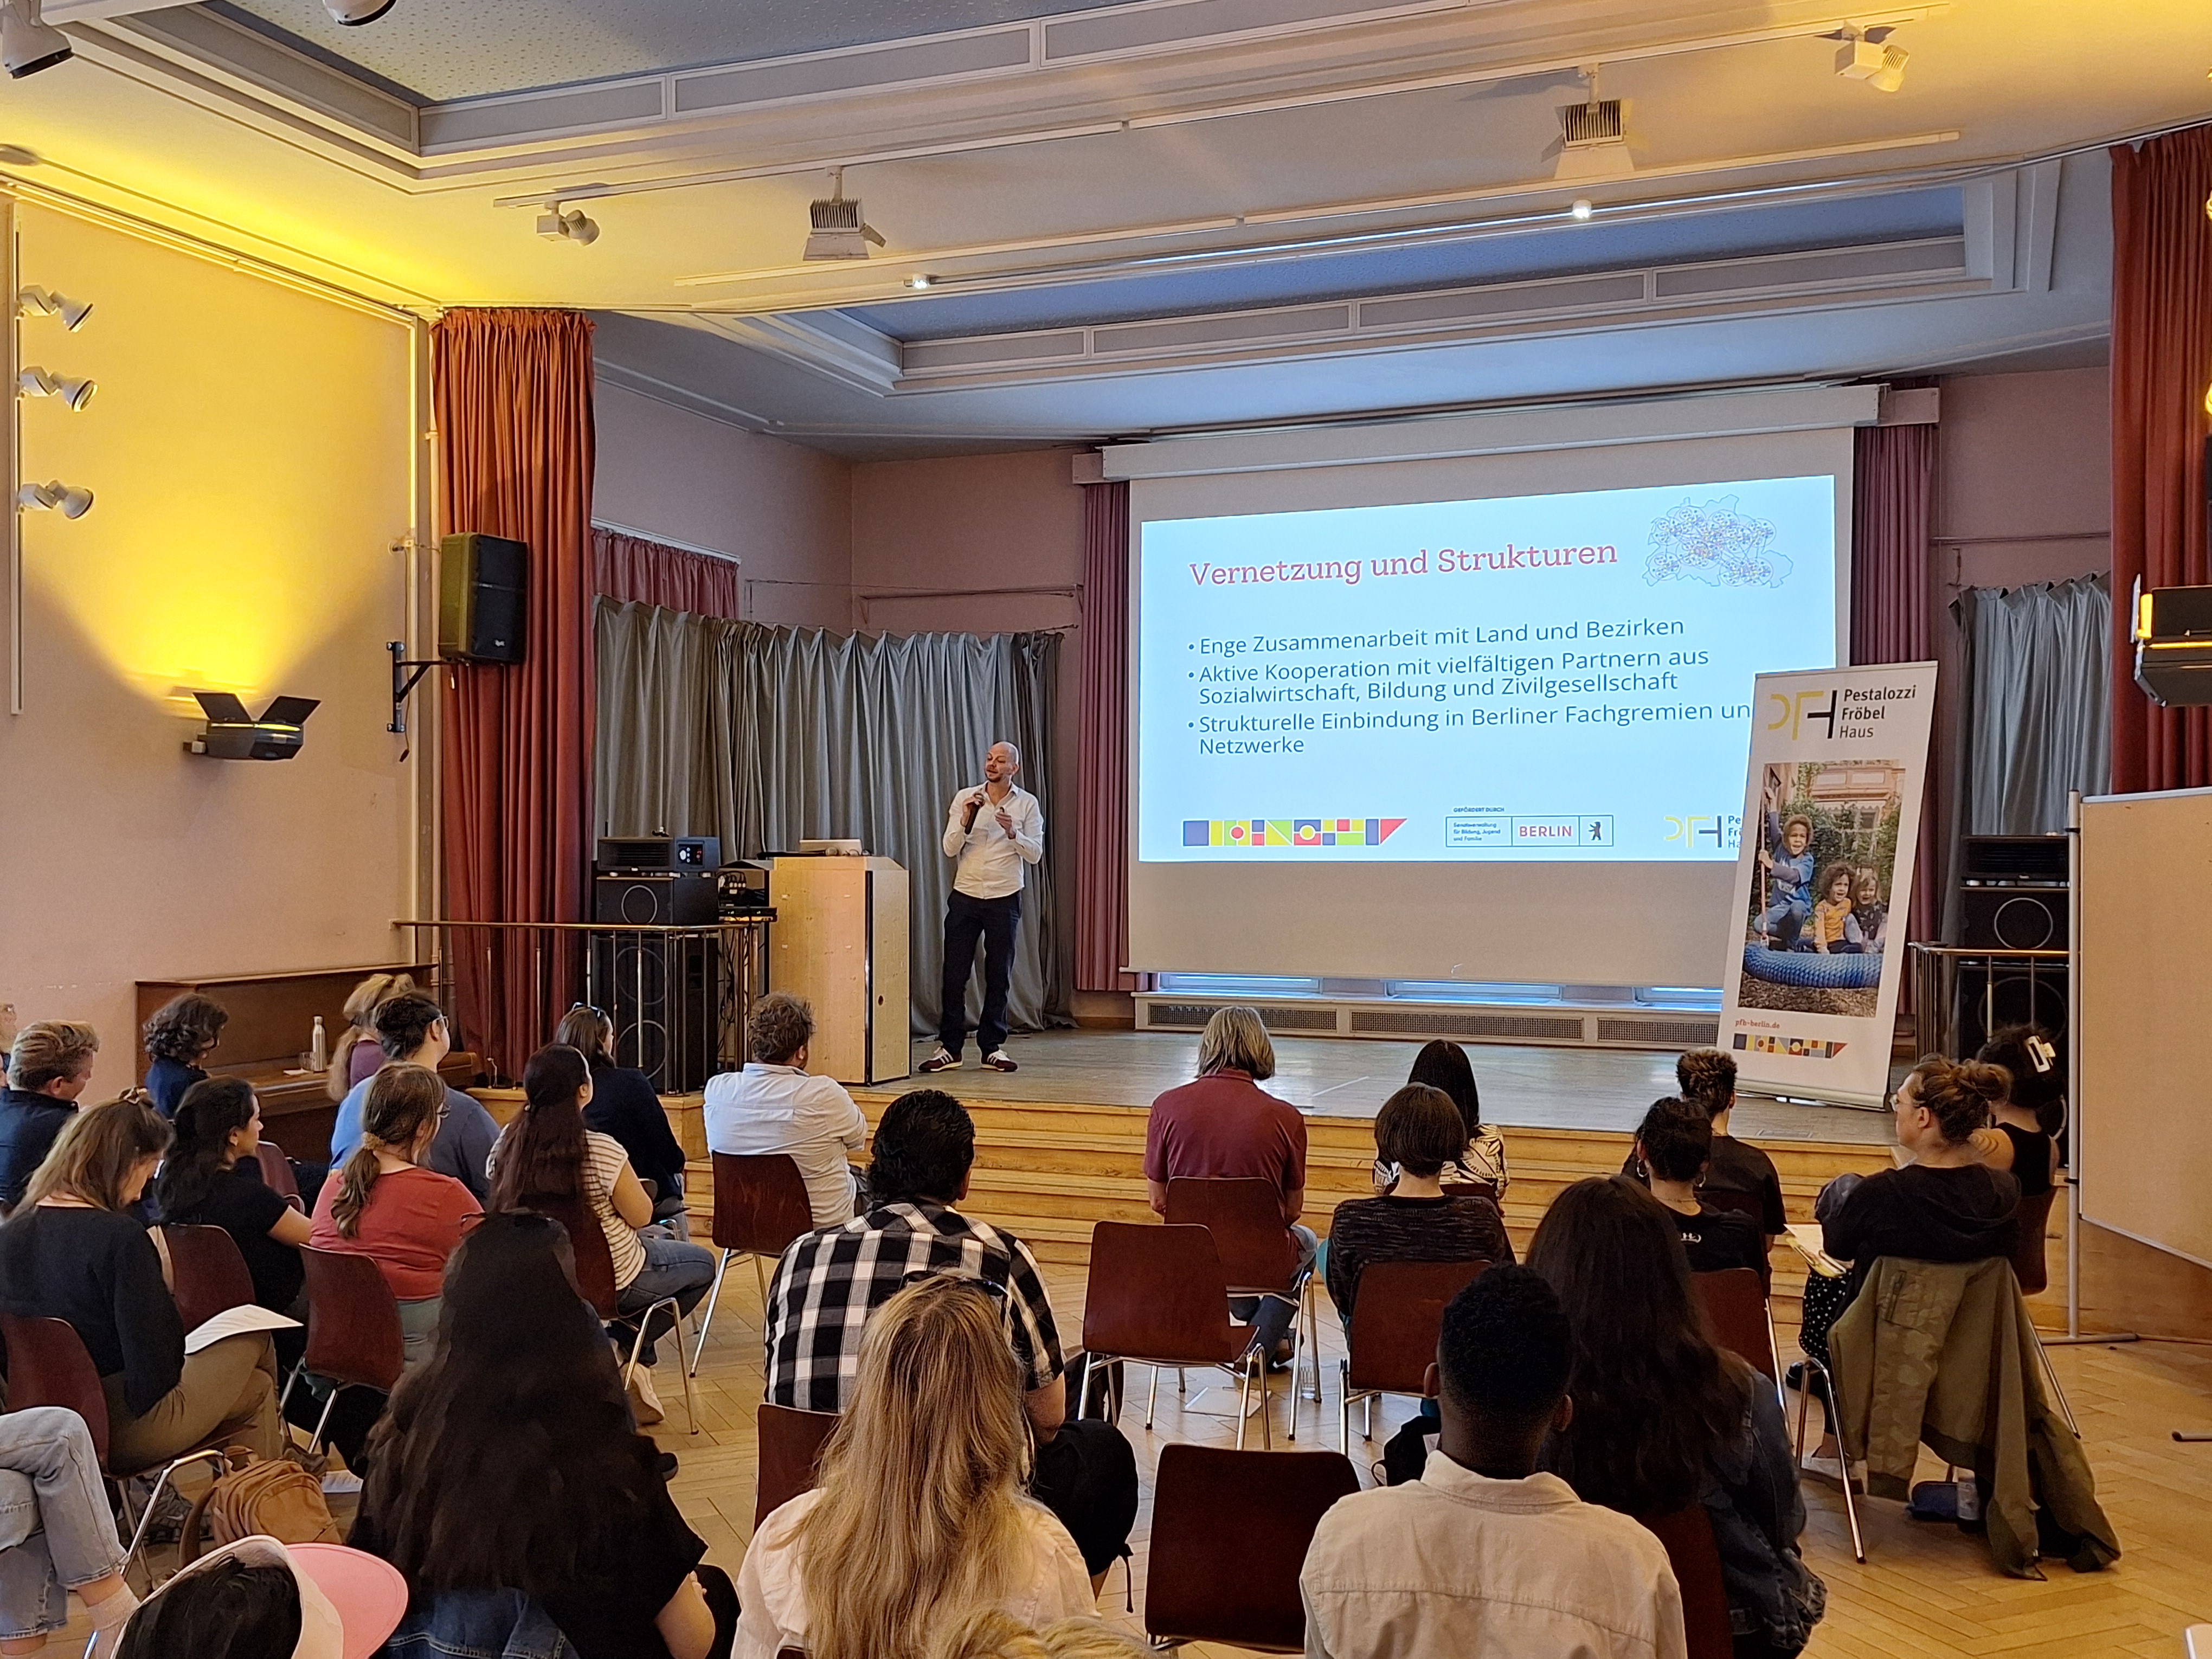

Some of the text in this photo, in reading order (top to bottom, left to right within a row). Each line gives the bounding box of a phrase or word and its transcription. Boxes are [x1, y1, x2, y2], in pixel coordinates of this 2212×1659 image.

[1189, 544, 1618, 586] Vernetzung und Strukturen
[1200, 618, 1684, 657] Enge Zusammenarbeit mit Land und Bezirken
[1199, 651, 1709, 683] Aktive Kooperation mit vielfältigen Partnern aus
[1199, 672, 1678, 704] Sozialwirtschaft, Bildung und Zivilgesellschaft
[1843, 684, 1917, 702] Pestalozzi
[1199, 703, 1751, 733] Strukturelle Einbindung in Berliner Fachgremien un
[1841, 705, 1885, 721] Fröbel
[1840, 725, 1874, 738] Haus
[1200, 736, 1304, 755] Netzwerke
[1519, 825, 1572, 837] BERLIN
[1735, 1019, 1780, 1029] pfh-berlin.de
